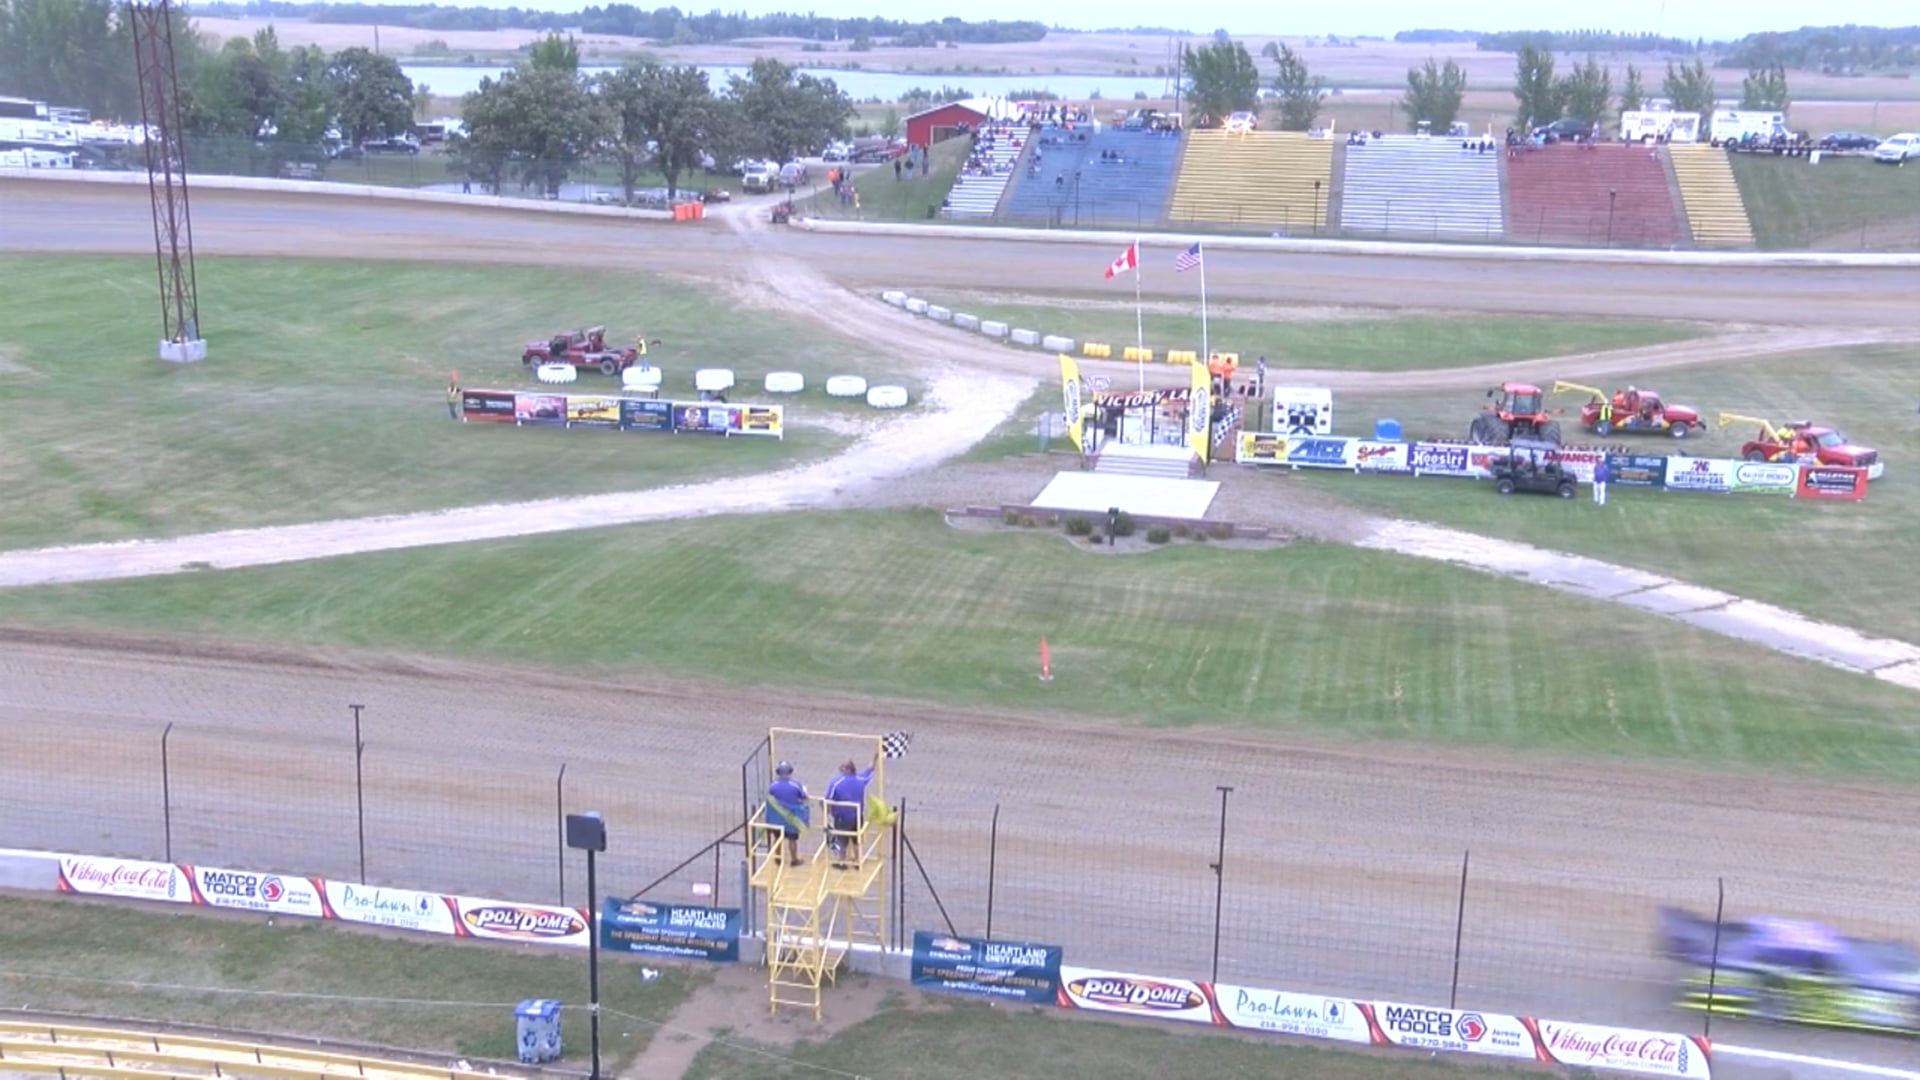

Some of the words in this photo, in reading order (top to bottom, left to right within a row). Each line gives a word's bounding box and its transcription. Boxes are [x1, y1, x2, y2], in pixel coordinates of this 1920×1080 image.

[1098, 392, 1165, 407] VICTORY
[66, 859, 110, 889] Viking
[204, 871, 257, 887] MATCO
[203, 883, 256, 897] TOOLS
[343, 885, 411, 913] Pro-Lawn
[671, 907, 727, 922] HEARTLAND
[670, 918, 693, 927] CHEVY
[694, 919, 726, 930] DEALERS
[986, 943, 1047, 958] HEARTLAND
[985, 953, 1010, 964] CHEVY
[1011, 956, 1046, 968] DEALERS
[1236, 989, 1318, 1019] Pro-Lawn
[1386, 1005, 1452, 1023] MATCO
[1387, 1018, 1452, 1037] TOOLS
[1546, 1024, 1601, 1061] Viking
